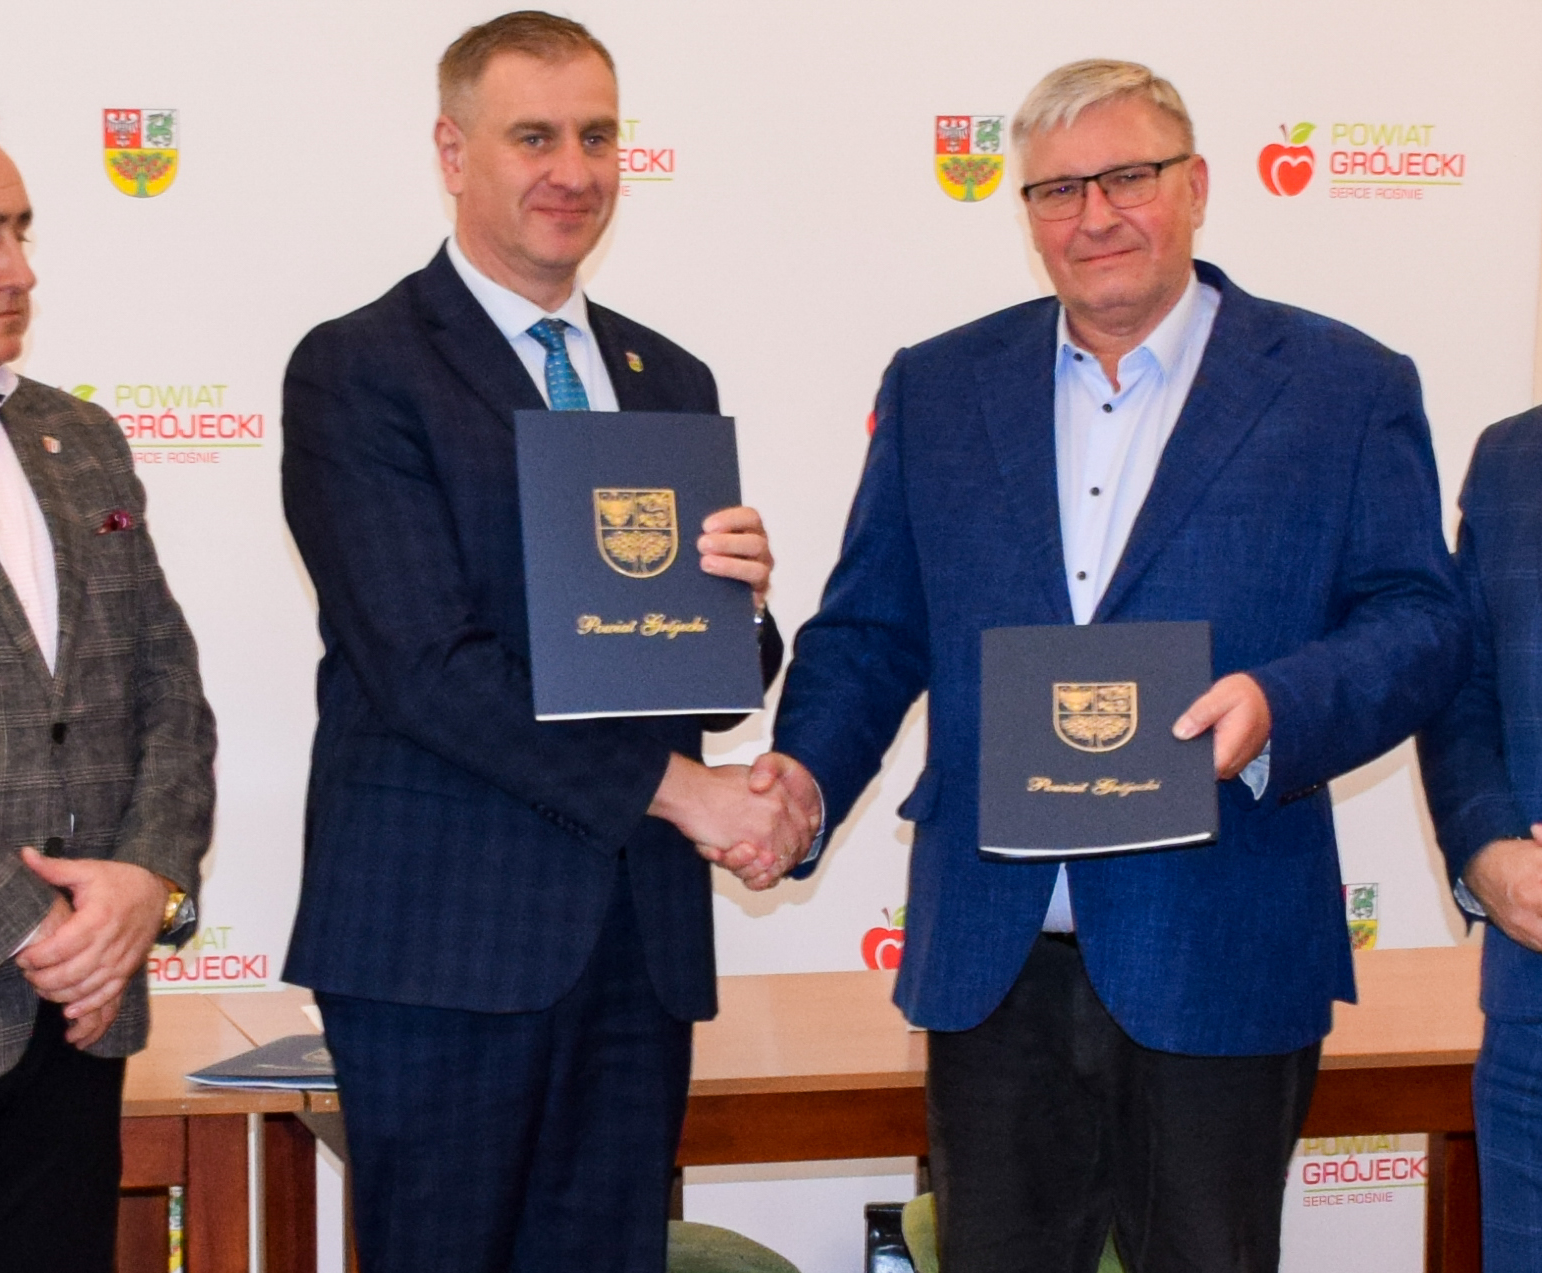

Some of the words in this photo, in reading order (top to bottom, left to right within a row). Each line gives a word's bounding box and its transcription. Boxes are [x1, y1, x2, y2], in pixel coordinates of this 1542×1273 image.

[1331, 123, 1435, 147] POWIAT
[1330, 146, 1466, 178] GRÓJECKI
[1329, 187, 1371, 200] SERCE
[115, 384, 227, 409] POWIAT
[117, 408, 264, 439] GRÓJECKI
[134, 452, 162, 464] RCE
[147, 953, 268, 982] RÓJECKI
[1303, 1155, 1429, 1185] GRÓJECK
[1303, 1194, 1344, 1207] SERCE
[1347, 1190, 1394, 1205] ROŚNIE
